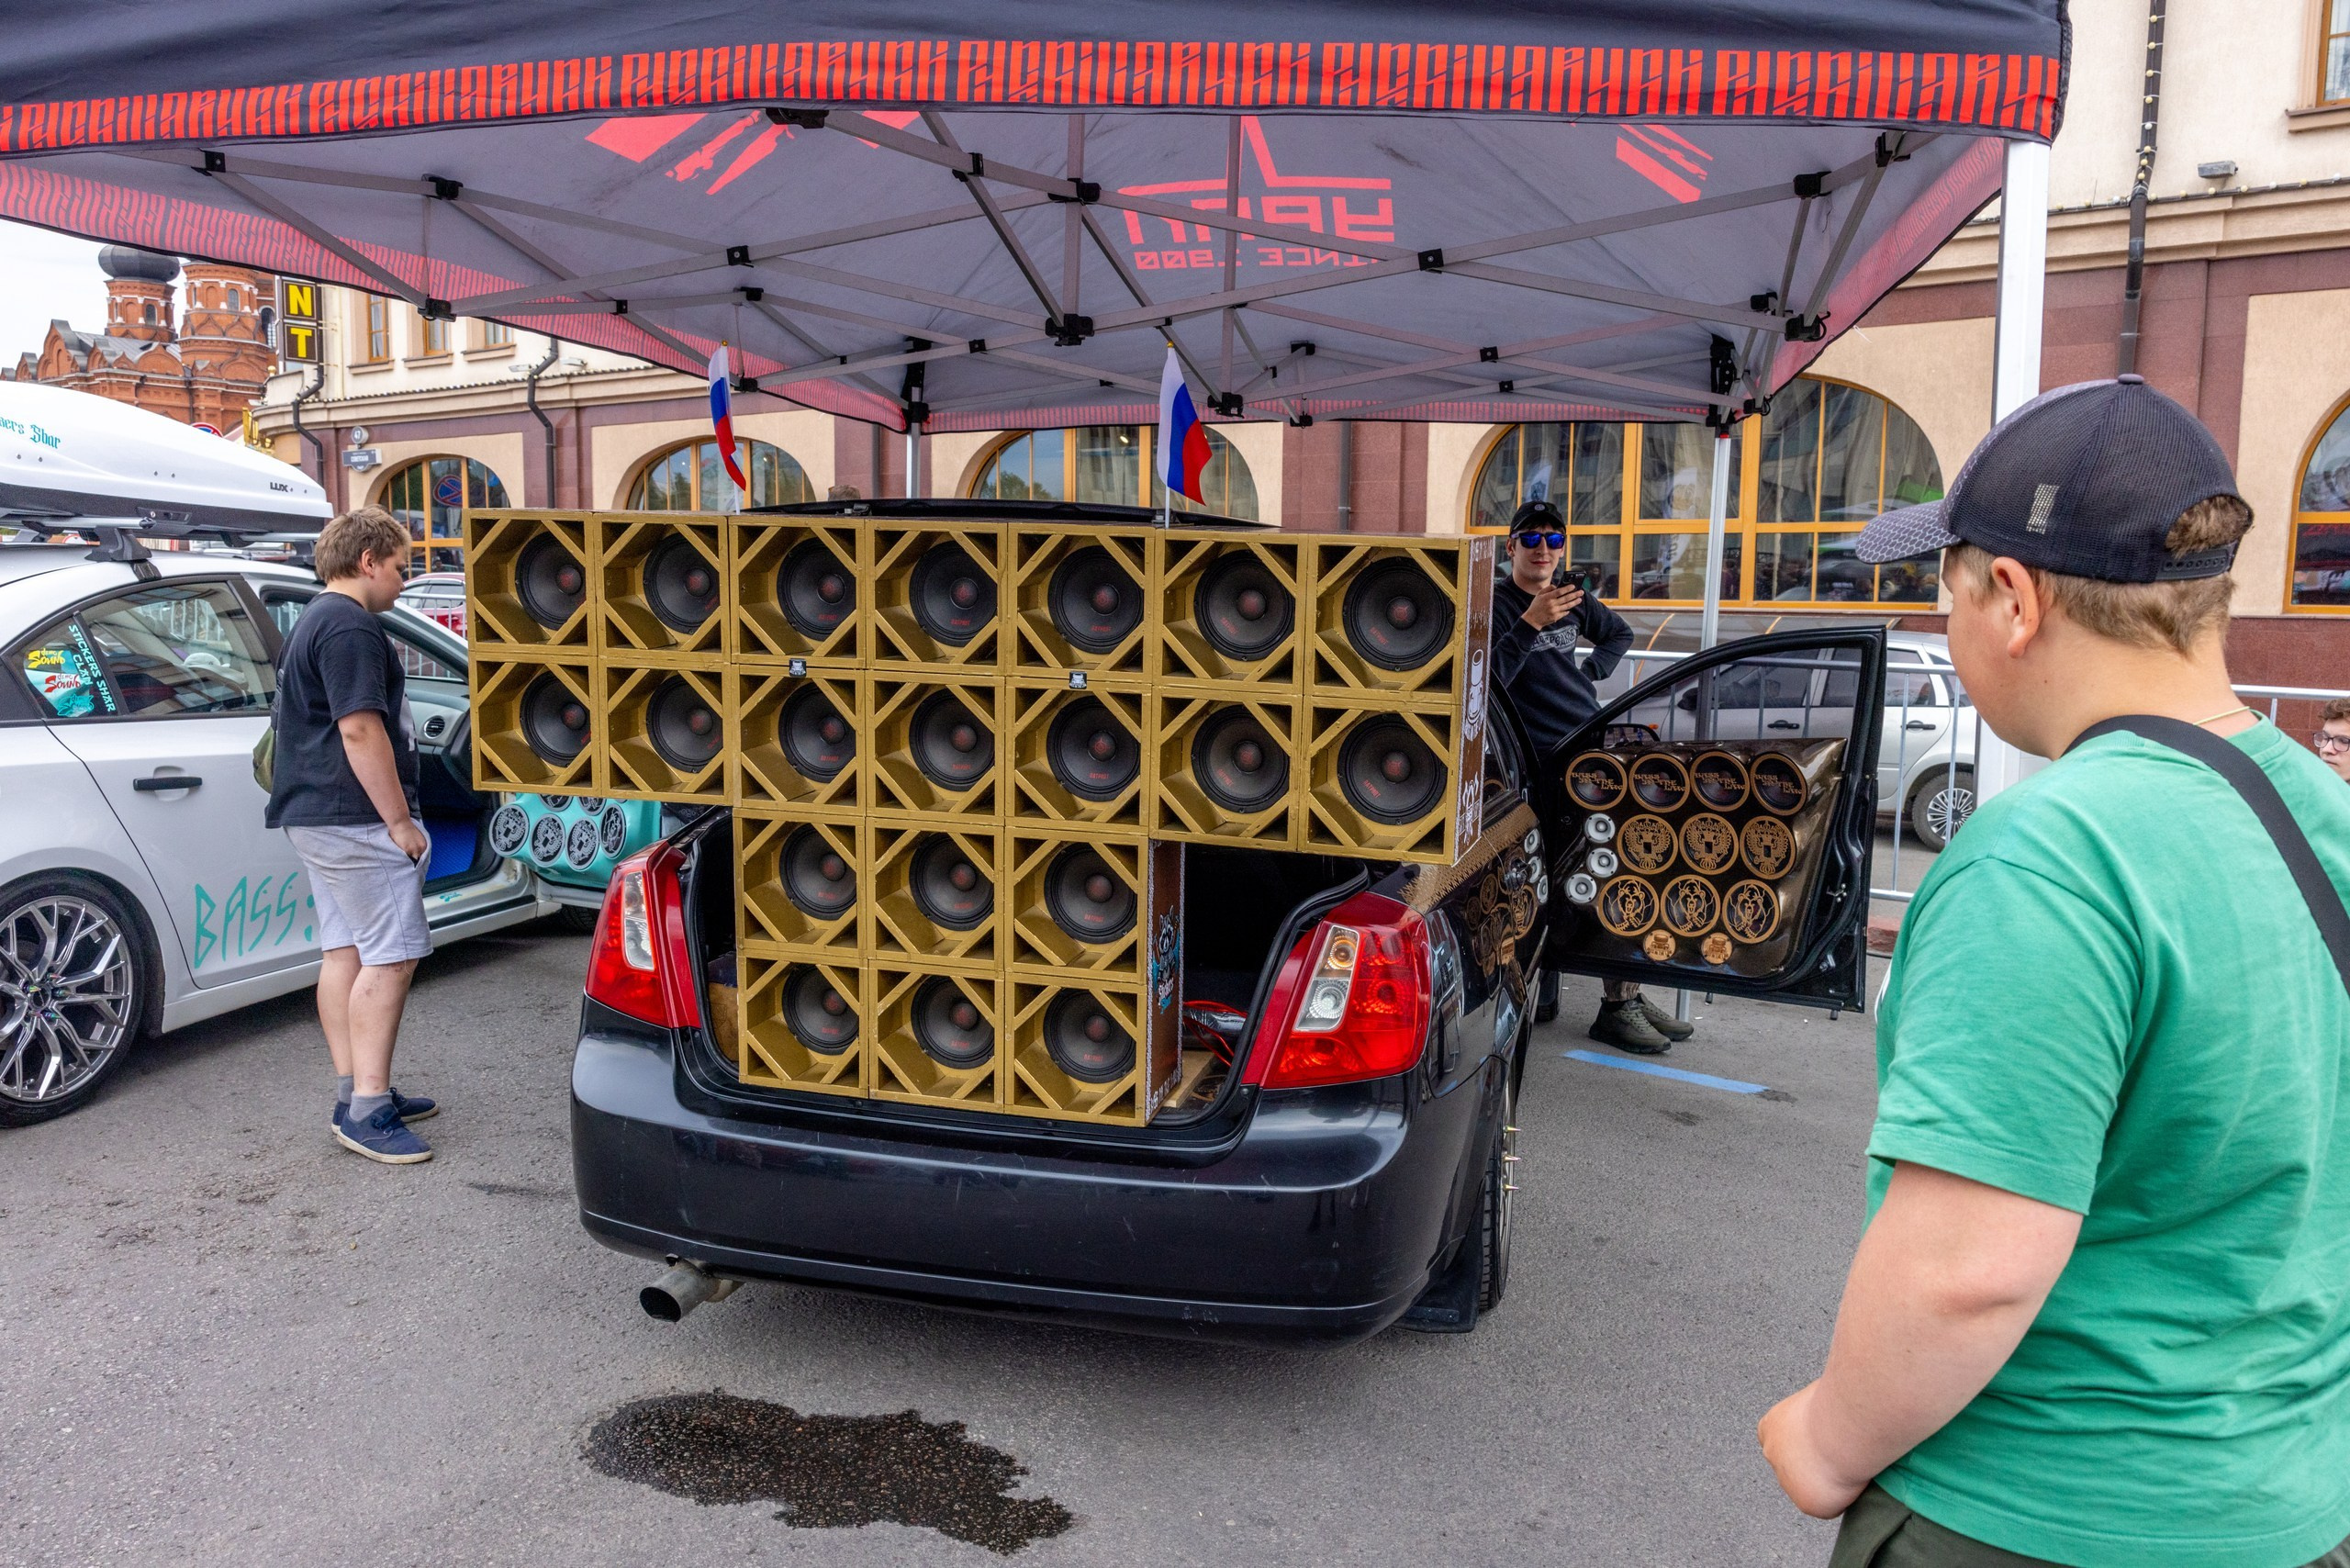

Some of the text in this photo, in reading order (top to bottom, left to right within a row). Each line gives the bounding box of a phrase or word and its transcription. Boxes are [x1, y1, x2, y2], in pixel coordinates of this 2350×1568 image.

[270, 482, 289, 493] LUX
[69, 624, 116, 711] STICKERS SHAR
[73, 655, 93, 685] CLAN
